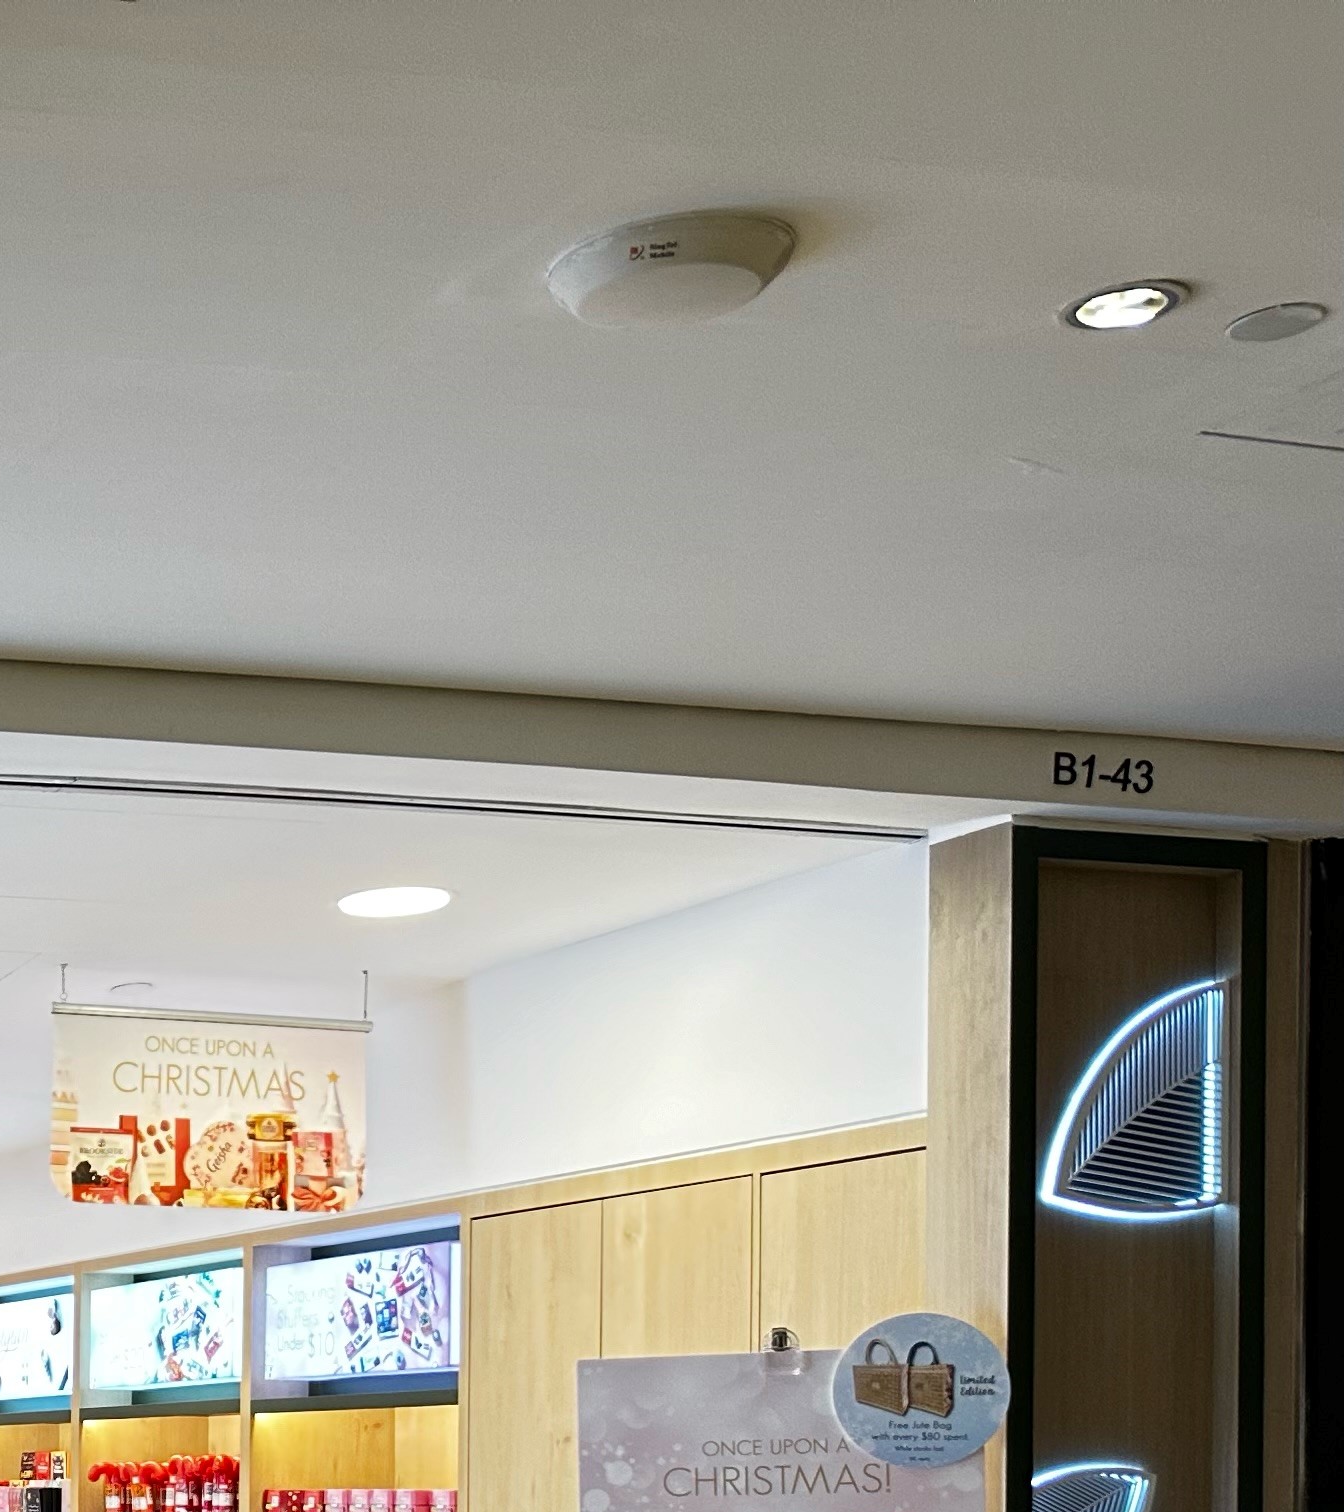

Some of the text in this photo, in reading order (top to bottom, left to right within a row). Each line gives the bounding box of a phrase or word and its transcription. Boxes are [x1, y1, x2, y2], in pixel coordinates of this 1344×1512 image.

[1053, 751, 1154, 794] B1-43
[144, 1035, 274, 1059] ONCE UPON A
[112, 1061, 307, 1101] CHRISTMAS
[888, 1420, 953, 1430] Free Jute Bag
[701, 1437, 851, 1457] ONCE UPON A
[663, 1462, 892, 1498] CHRISTMAS!
